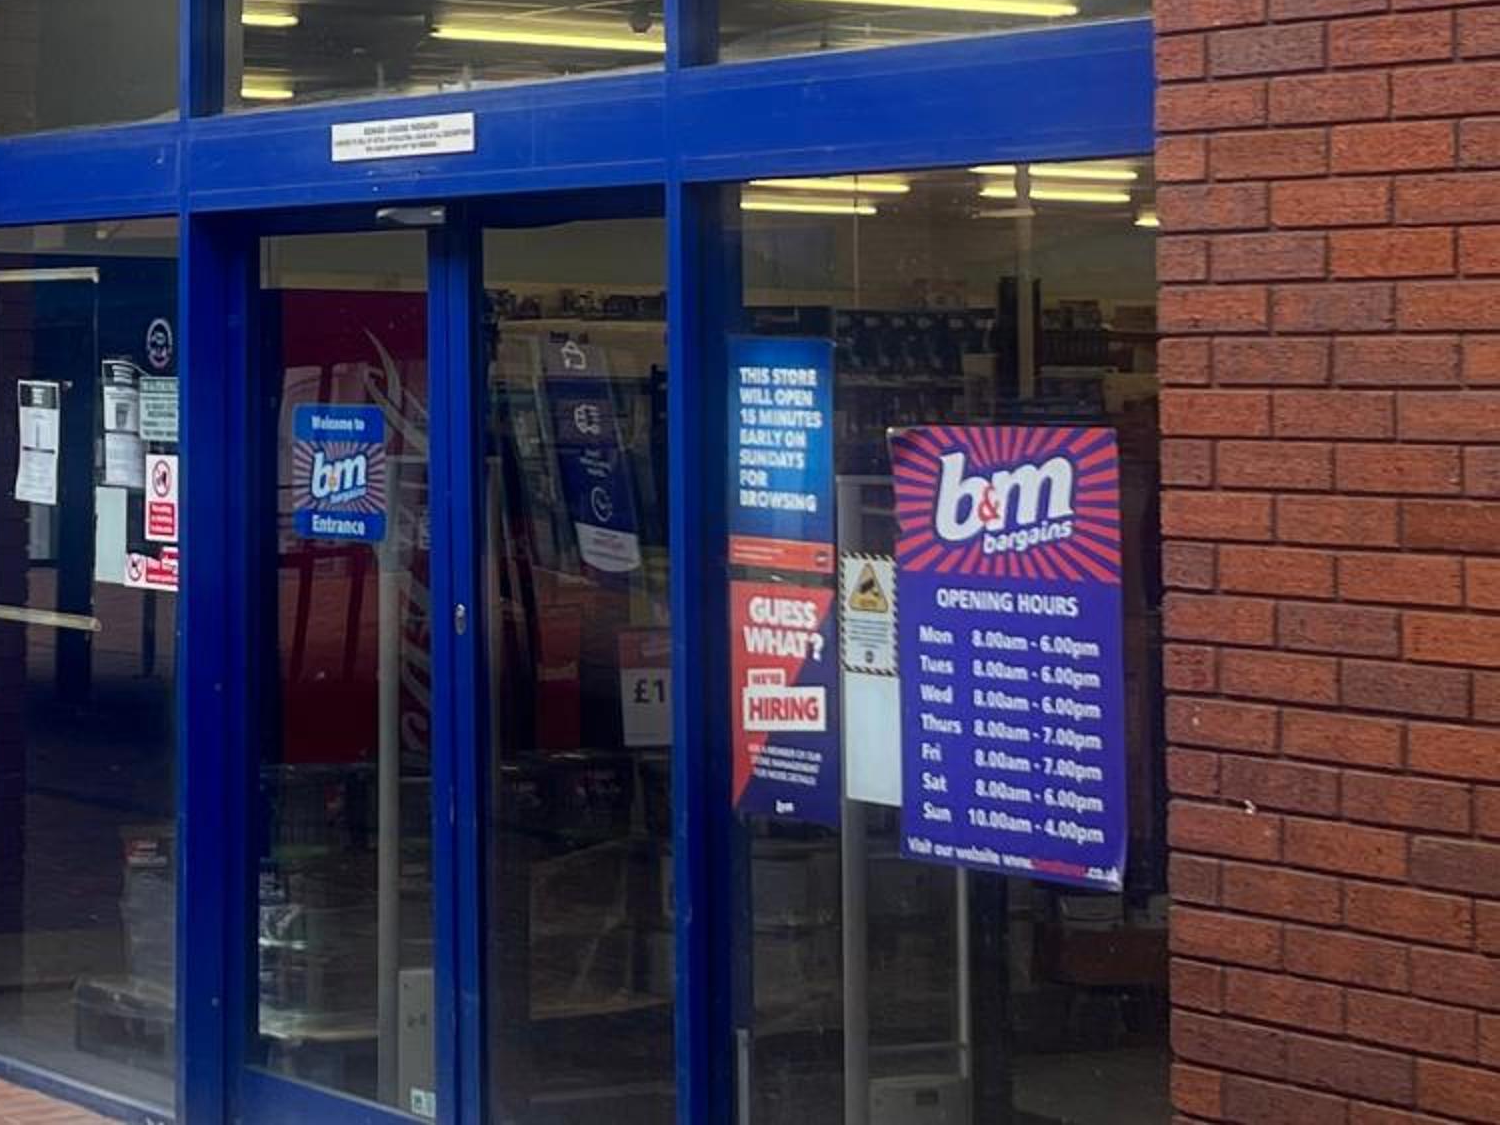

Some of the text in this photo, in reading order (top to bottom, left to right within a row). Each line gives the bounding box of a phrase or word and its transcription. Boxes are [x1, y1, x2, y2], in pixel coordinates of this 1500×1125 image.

[740, 368, 817, 386] THIS STORE
[740, 388, 813, 405] WILL OPEN
[740, 409, 822, 428] 15 MINUTES
[740, 429, 806, 448] EARLY ON
[740, 450, 805, 469] SUNDAYS
[740, 470, 768, 486] FOR
[740, 489, 817, 512] BROWSING
[936, 452, 1075, 542] b&m
[312, 514, 365, 535] Entrance
[983, 521, 1073, 555] bargains
[750, 597, 817, 628] GUESS
[936, 588, 1078, 618] OPENING HOURS
[744, 627, 824, 661] WHAT?
[919, 625, 954, 644] Mon
[972, 630, 1029, 652] 8.00am
[1040, 635, 1100, 659] 6.00pm
[920, 655, 954, 674] Tues
[972, 659, 1029, 681] 8.00am
[1041, 666, 1100, 690] 6.00pm
[749, 697, 819, 722] HIRING
[920, 684, 954, 704] Wed
[973, 689, 1030, 712] 8.00am
[1042, 696, 1101, 721] 6.00pm
[921, 713, 962, 735] Thurs
[974, 719, 1030, 742] 8.00am
[1042, 727, 1102, 752] 7.00pm
[922, 743, 942, 762] Fri
[975, 749, 1031, 772] 8.00am
[1042, 757, 1102, 783] 7.00pm
[922, 773, 948, 792] Sat
[975, 779, 1031, 802] 8.00am
[1044, 788, 1103, 813] 6.00pm
[923, 802, 952, 822] Sun
[968, 808, 1032, 833] 10.00am
[1044, 819, 1104, 845] 4.00pm
[908, 836, 932, 855] Visit
[934, 843, 953, 858] our
